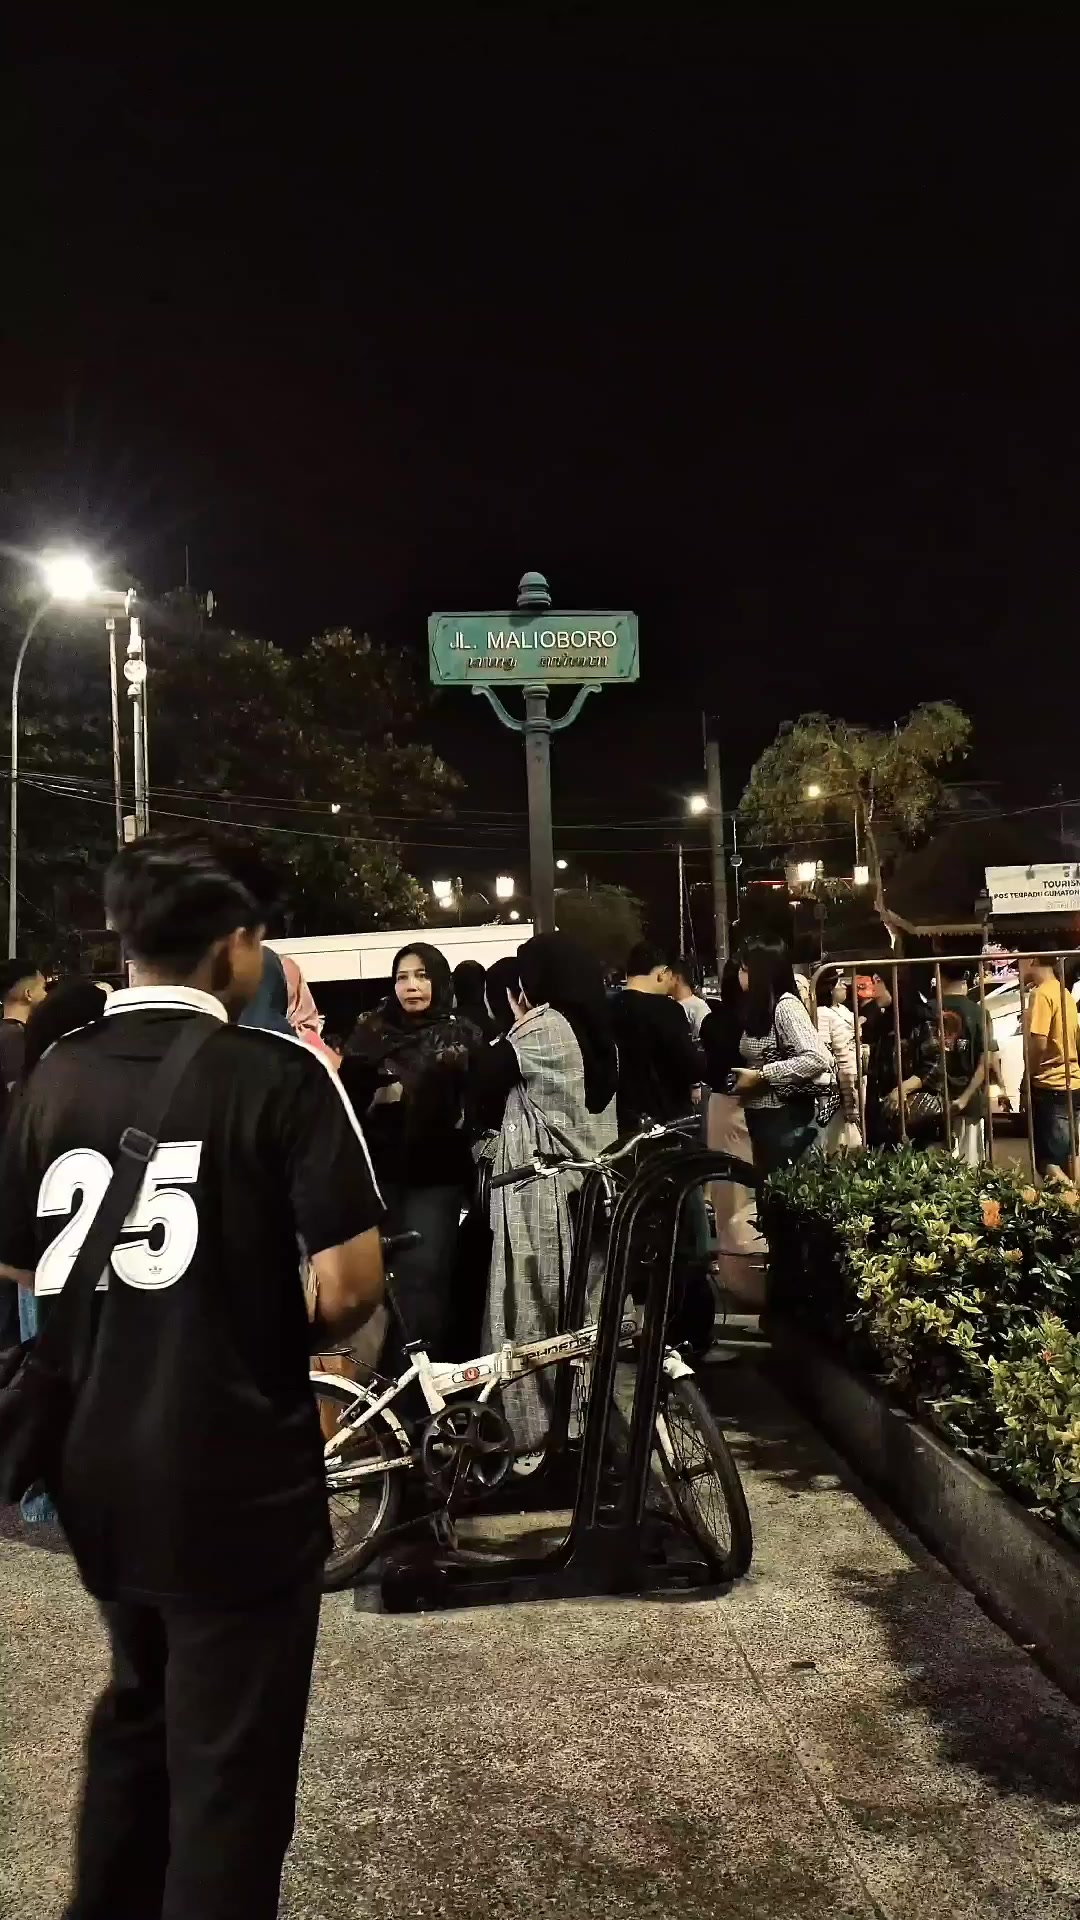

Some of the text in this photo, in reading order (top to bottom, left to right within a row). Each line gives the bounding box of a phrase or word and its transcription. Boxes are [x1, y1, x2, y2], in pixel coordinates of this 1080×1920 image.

[450, 630, 618, 650] JL. MALIOBORO
[34, 1140, 203, 1297] 25
